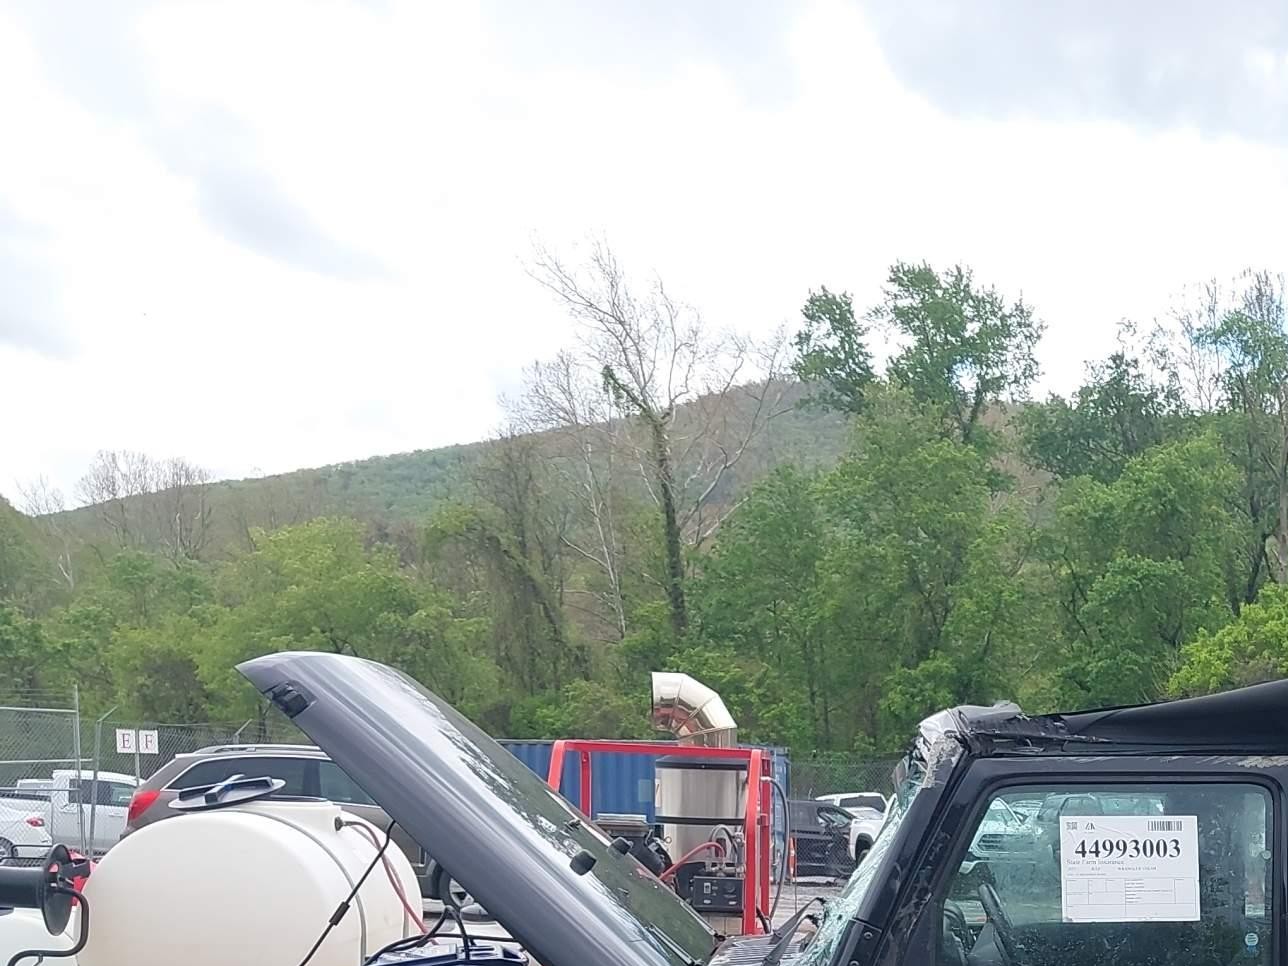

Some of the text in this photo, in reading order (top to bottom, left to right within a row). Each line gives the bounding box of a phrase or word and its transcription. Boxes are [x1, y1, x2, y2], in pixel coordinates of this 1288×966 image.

[121, 733, 131, 749] E
[144, 734, 154, 749] F
[1075, 839, 1181, 858] 44993003
